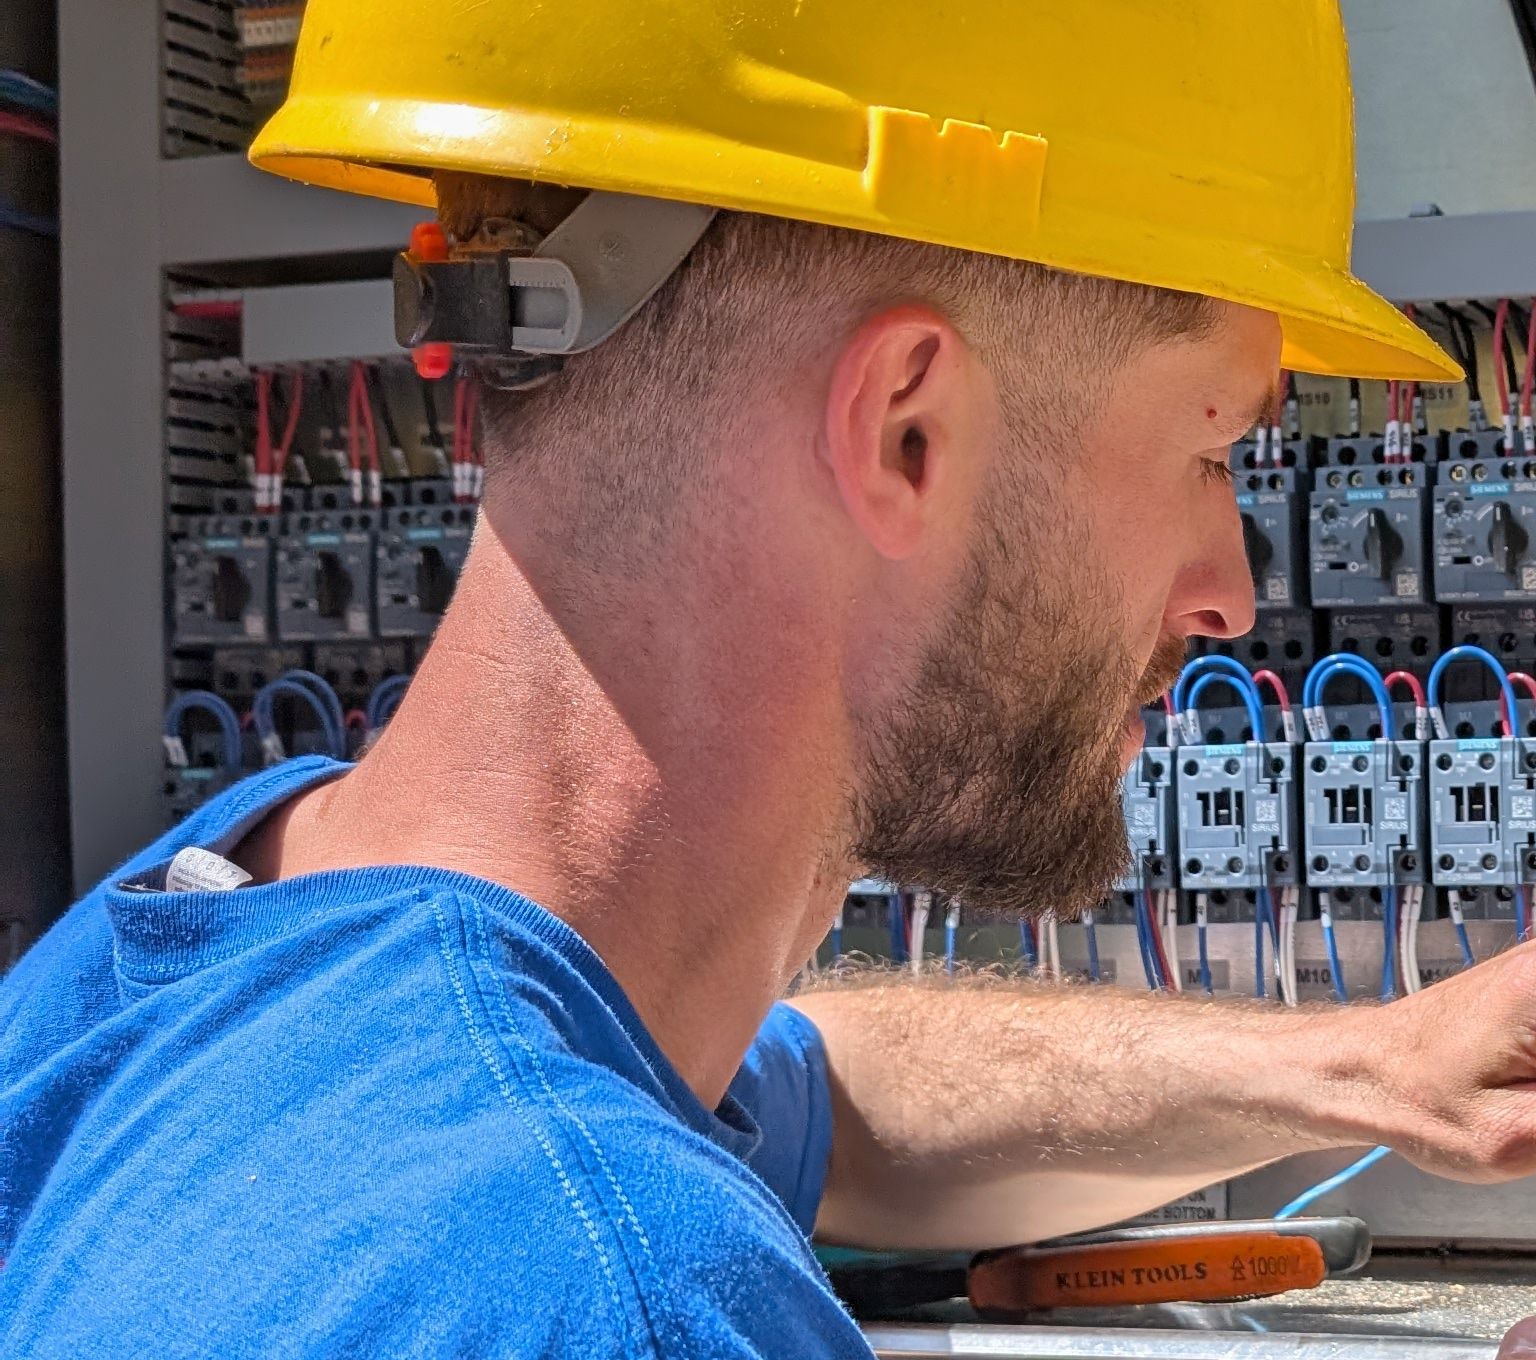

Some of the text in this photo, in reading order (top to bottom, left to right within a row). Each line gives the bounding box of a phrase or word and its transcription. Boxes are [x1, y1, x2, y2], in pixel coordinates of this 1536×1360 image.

[1458, 741, 1498, 751] SIEMENS
[1251, 823, 1280, 833] SIRIUS
[1380, 821, 1409, 830] SIRIUS
[1508, 820, 1536, 829] SIRIUS
[1056, 1268, 1125, 1290] KLEIN
[1131, 1262, 1208, 1285] TOOLS
